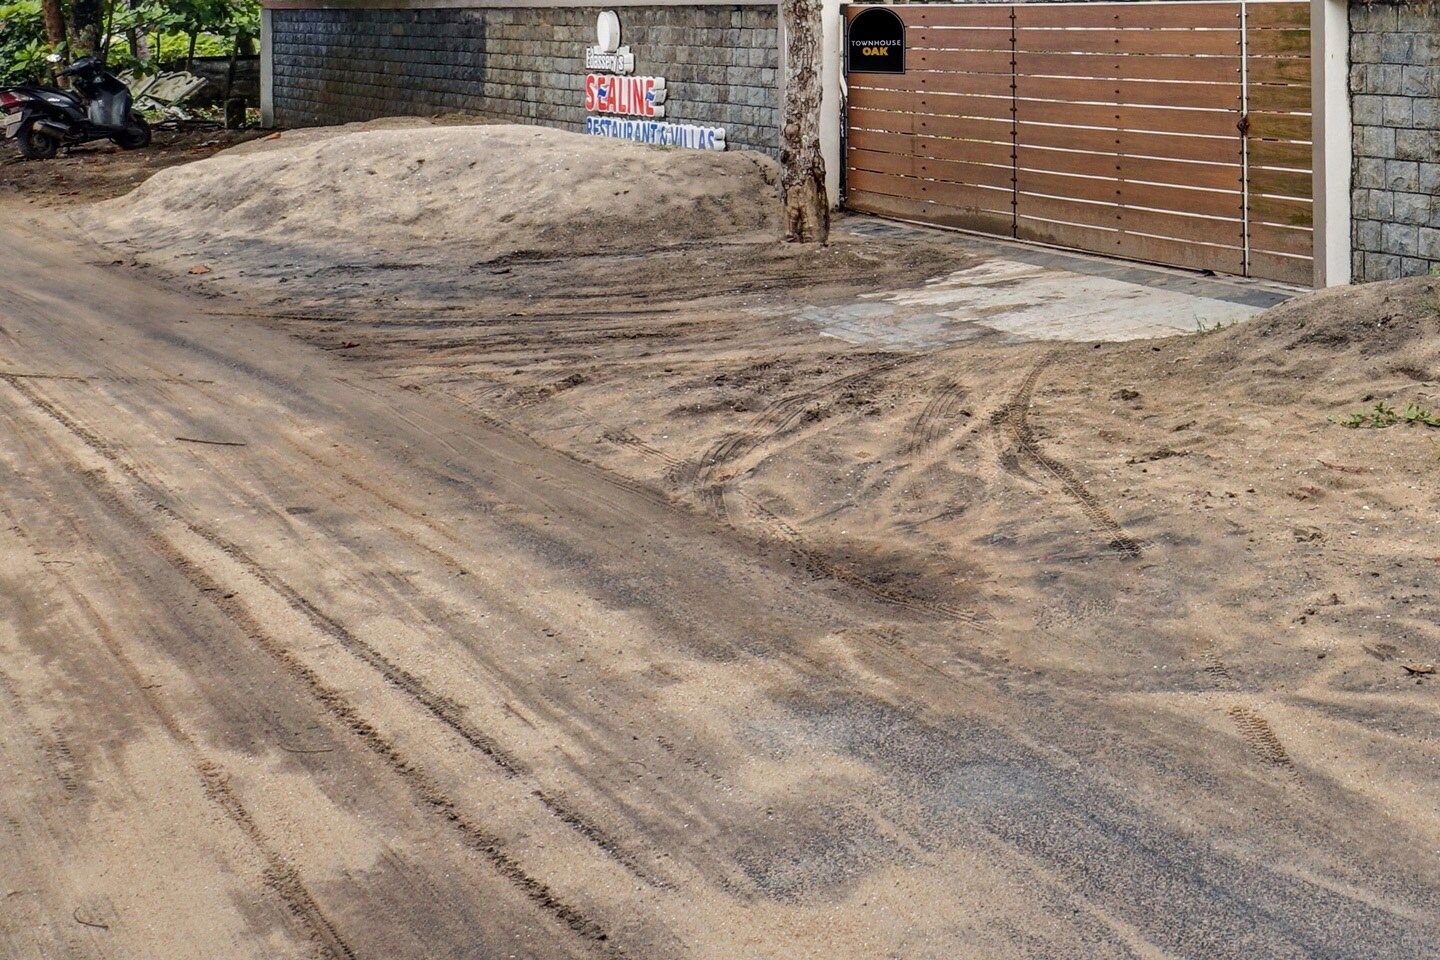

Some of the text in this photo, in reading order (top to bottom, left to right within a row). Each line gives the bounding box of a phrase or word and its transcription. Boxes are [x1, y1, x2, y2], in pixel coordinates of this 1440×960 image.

[863, 47, 888, 56] OAK
[586, 75, 655, 116] SEALINE
[586, 117, 715, 150] RESTAURANT & VILLAS
